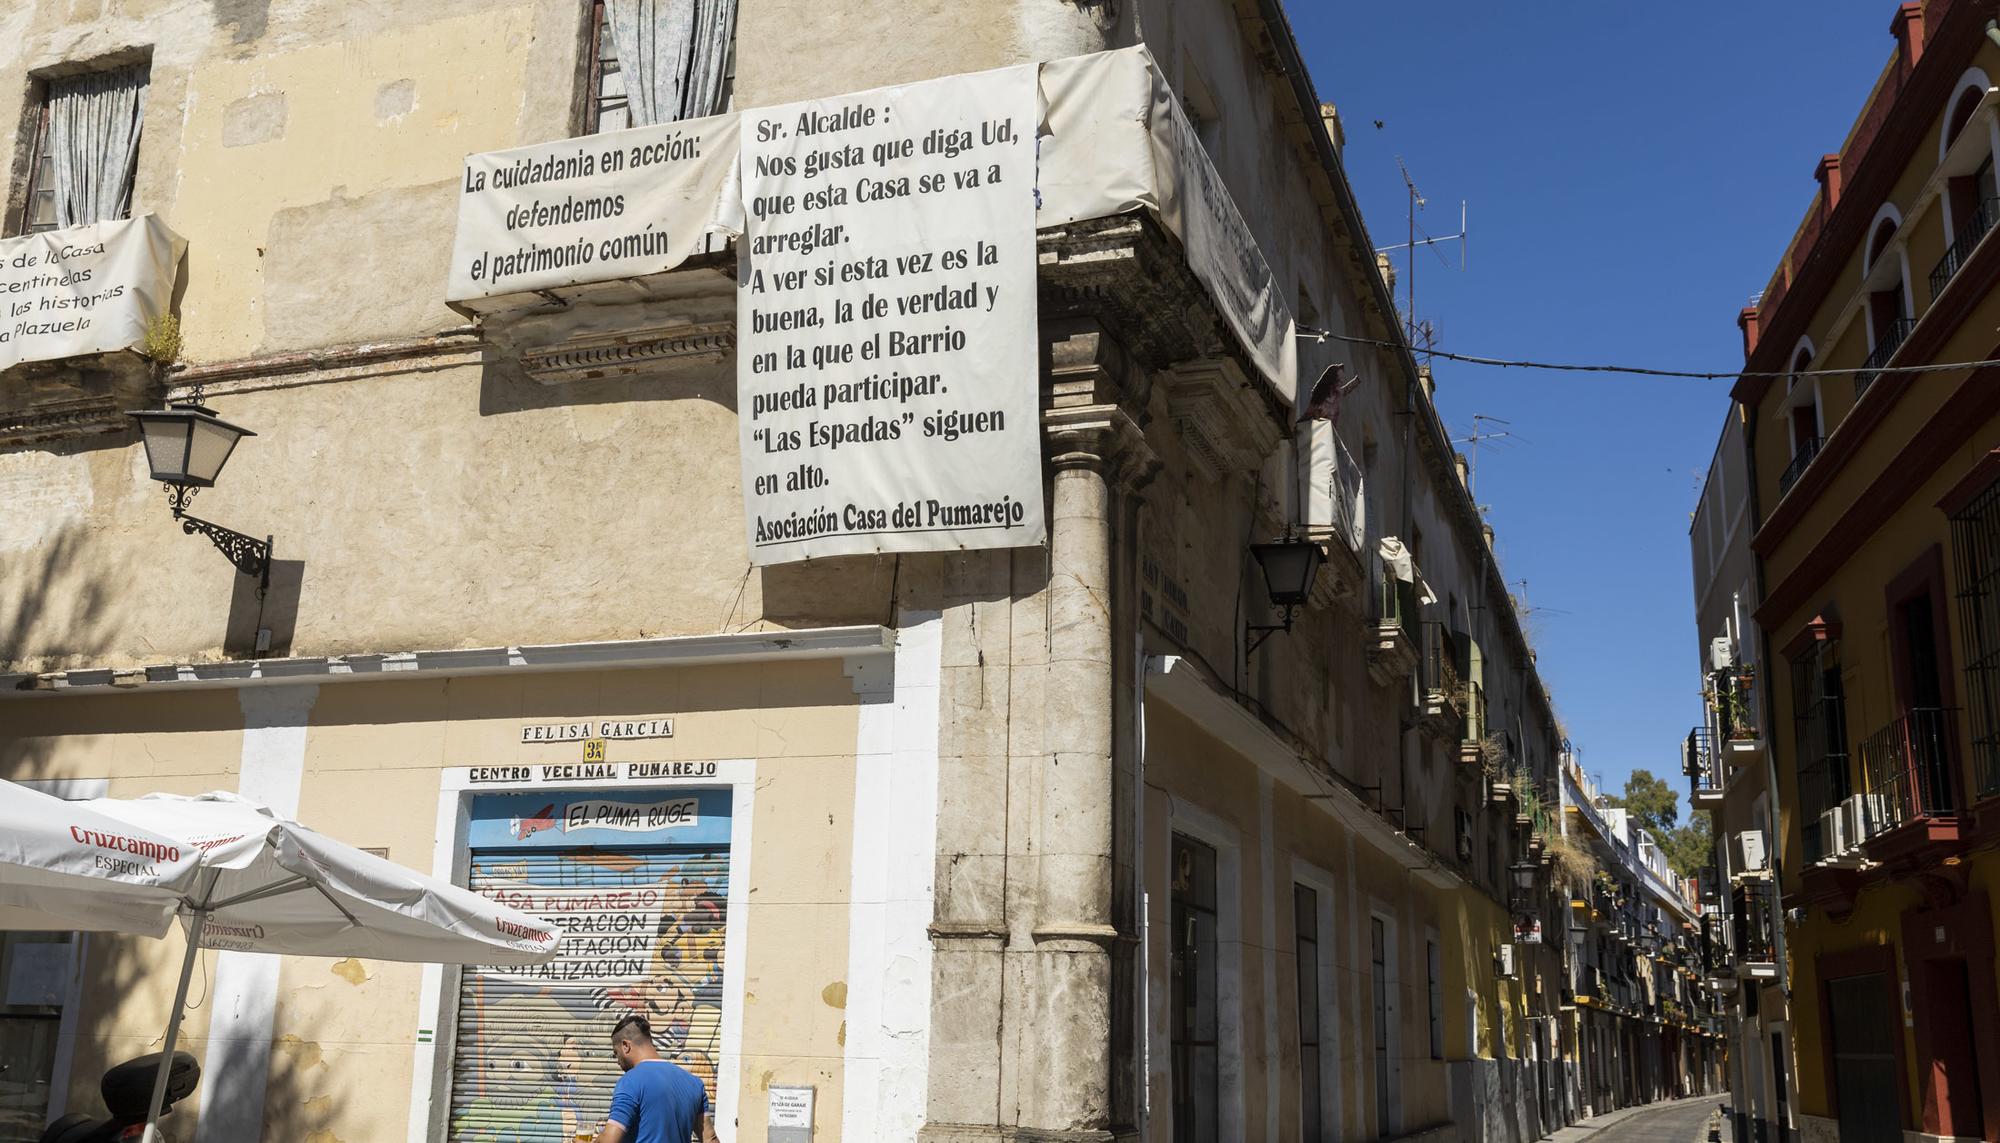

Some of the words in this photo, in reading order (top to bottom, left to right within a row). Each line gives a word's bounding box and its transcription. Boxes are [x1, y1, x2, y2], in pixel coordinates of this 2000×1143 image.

[756, 119, 787, 143] Sr.
[795, 104, 876, 137] Alcalde
[465, 166, 485, 193] La
[492, 149, 594, 190] cuidadania
[601, 147, 624, 173] en
[630, 131, 701, 169] acción:
[755, 153, 797, 179] Nos
[804, 145, 865, 179] gusta
[872, 136, 914, 167] que
[922, 129, 974, 159] diga
[981, 118, 1019, 147] Ud,
[752, 194, 796, 222] que
[803, 185, 848, 211] esta
[855, 176, 910, 204] Casa
[918, 172, 946, 194] se
[953, 168, 980, 190] va
[987, 163, 1003, 184] a
[506, 194, 625, 231] defendemos
[12, 253, 38, 269] de
[45, 250, 59, 264] la
[61, 242, 105, 259] Casa
[470, 251, 487, 281] el
[492, 237, 594, 284] patrimonio
[600, 223, 669, 262] común
[751, 223, 850, 256] arreglar.
[0, 268, 92, 294] centinelas
[751, 270, 766, 295] A
[773, 268, 808, 292] ver
[814, 260, 835, 287] si
[840, 257, 889, 281] esta
[896, 251, 934, 276] vez
[941, 247, 968, 270] es
[976, 240, 999, 267] la
[10, 301, 33, 318] las
[39, 284, 125, 311] historias
[751, 307, 825, 335] buena,
[834, 298, 854, 325] la
[861, 290, 889, 319] de
[896, 281, 978, 316] verdad
[985, 284, 1000, 313] y
[14, 317, 92, 339] Plazuela
[752, 352, 777, 374] en
[786, 344, 805, 371] la
[812, 343, 854, 374] que
[860, 333, 880, 362] el
[888, 326, 967, 357] Barrio
[752, 384, 817, 421] pueda
[823, 370, 948, 409] participar.
[753, 426, 802, 454] “Las
[809, 412, 915, 450] Espadas”
[922, 409, 1005, 442] siguen
[755, 473, 778, 496] en
[786, 463, 830, 493] alto.
[755, 505, 838, 543] Asociación
[843, 503, 887, 531] Casa
[891, 499, 922, 529] del
[925, 495, 1024, 530] Pumarejo
[523, 724, 591, 740] FELISA
[600, 721, 672, 736] GARCIA
[469, 767, 531, 780] CENTRO
[542, 764, 616, 779] VECINAL
[628, 762, 716, 776] PUMAREJO
[568, 805, 590, 828] EL
[595, 805, 641, 827] PUMA
[647, 801, 696, 828] RUGE
[70, 825, 180, 864] Cruzcampo
[95, 855, 161, 877] ESPECIAL
[482, 885, 536, 910] CASA
[544, 889, 658, 912] PUMAREJO
[495, 916, 553, 943] Cruzcampo
